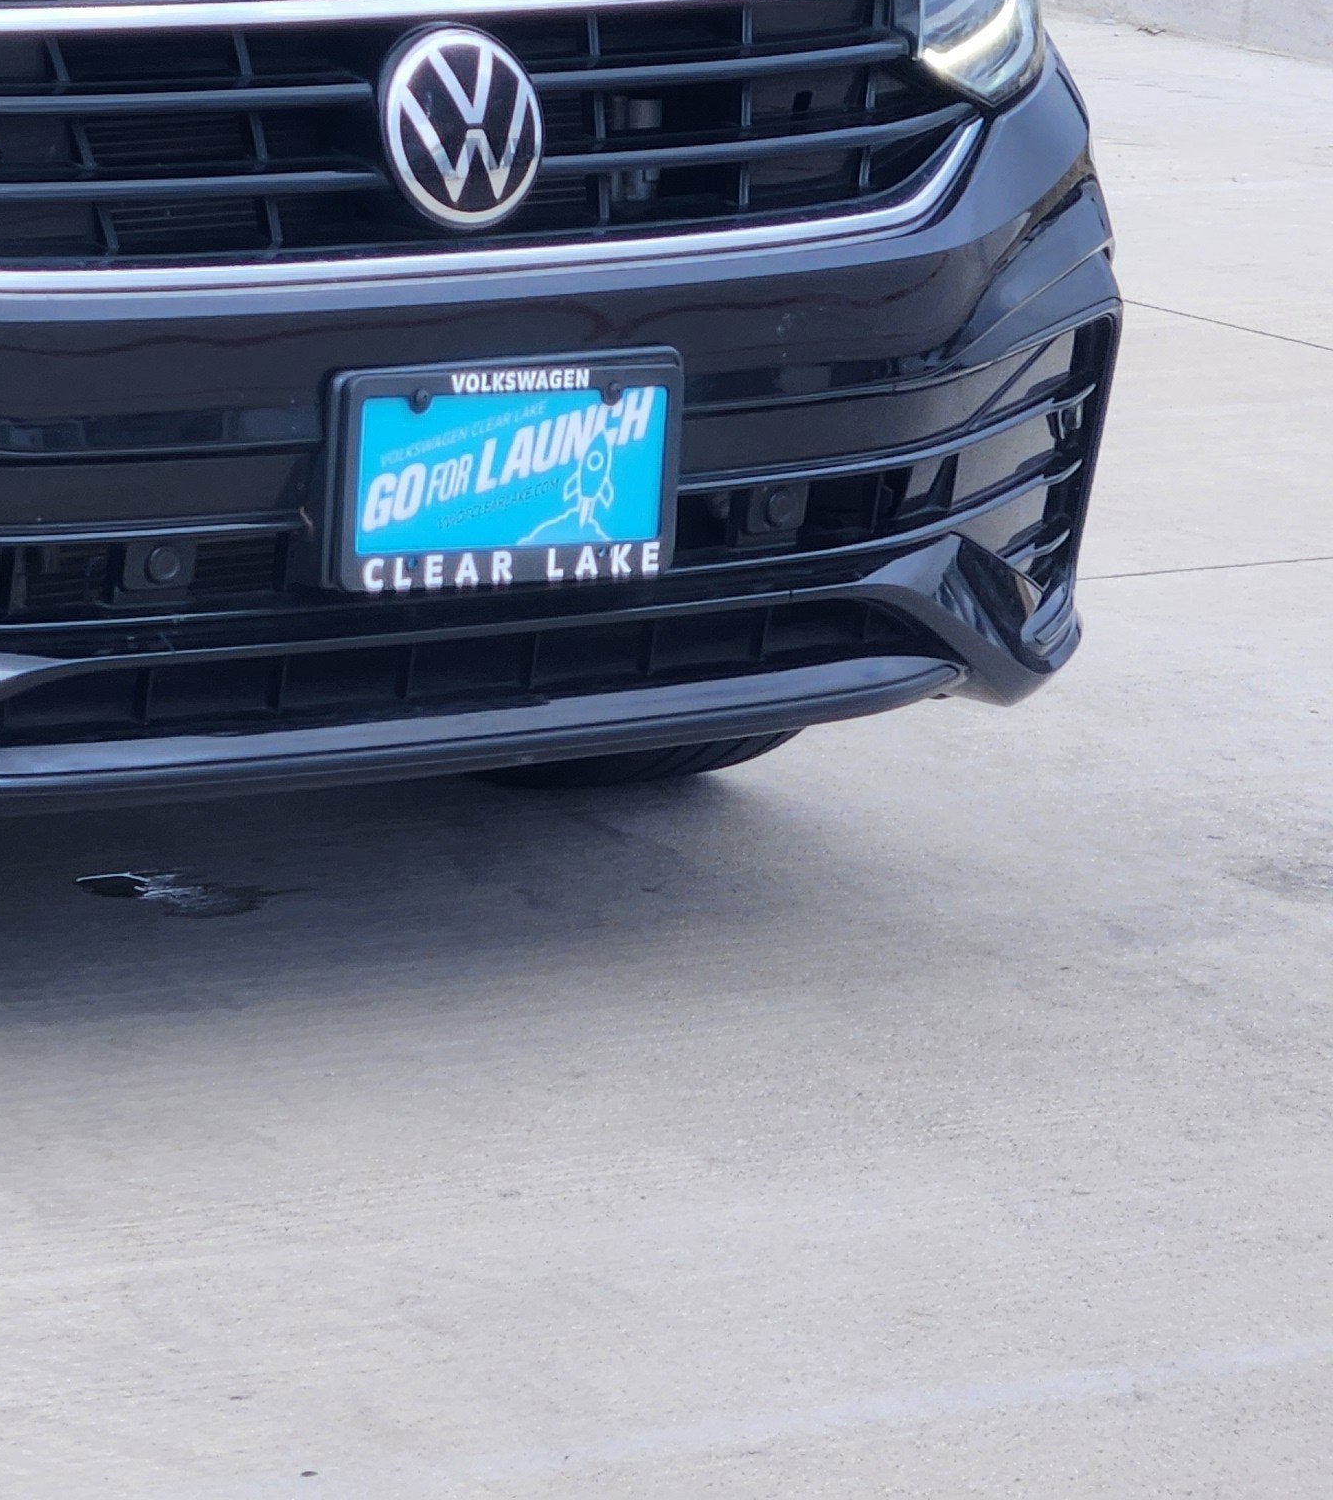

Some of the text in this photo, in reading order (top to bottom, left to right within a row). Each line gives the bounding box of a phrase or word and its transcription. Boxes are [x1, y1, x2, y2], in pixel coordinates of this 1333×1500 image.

[387, 27, 542, 224] VW
[451, 368, 590, 394] VOLKSWAGEN
[362, 386, 655, 532] GO FOR LAUNCH
[381, 401, 548, 468] VOLKSWAGEN CLEAR LAKE
[363, 542, 661, 591] CLEAR LAKE
